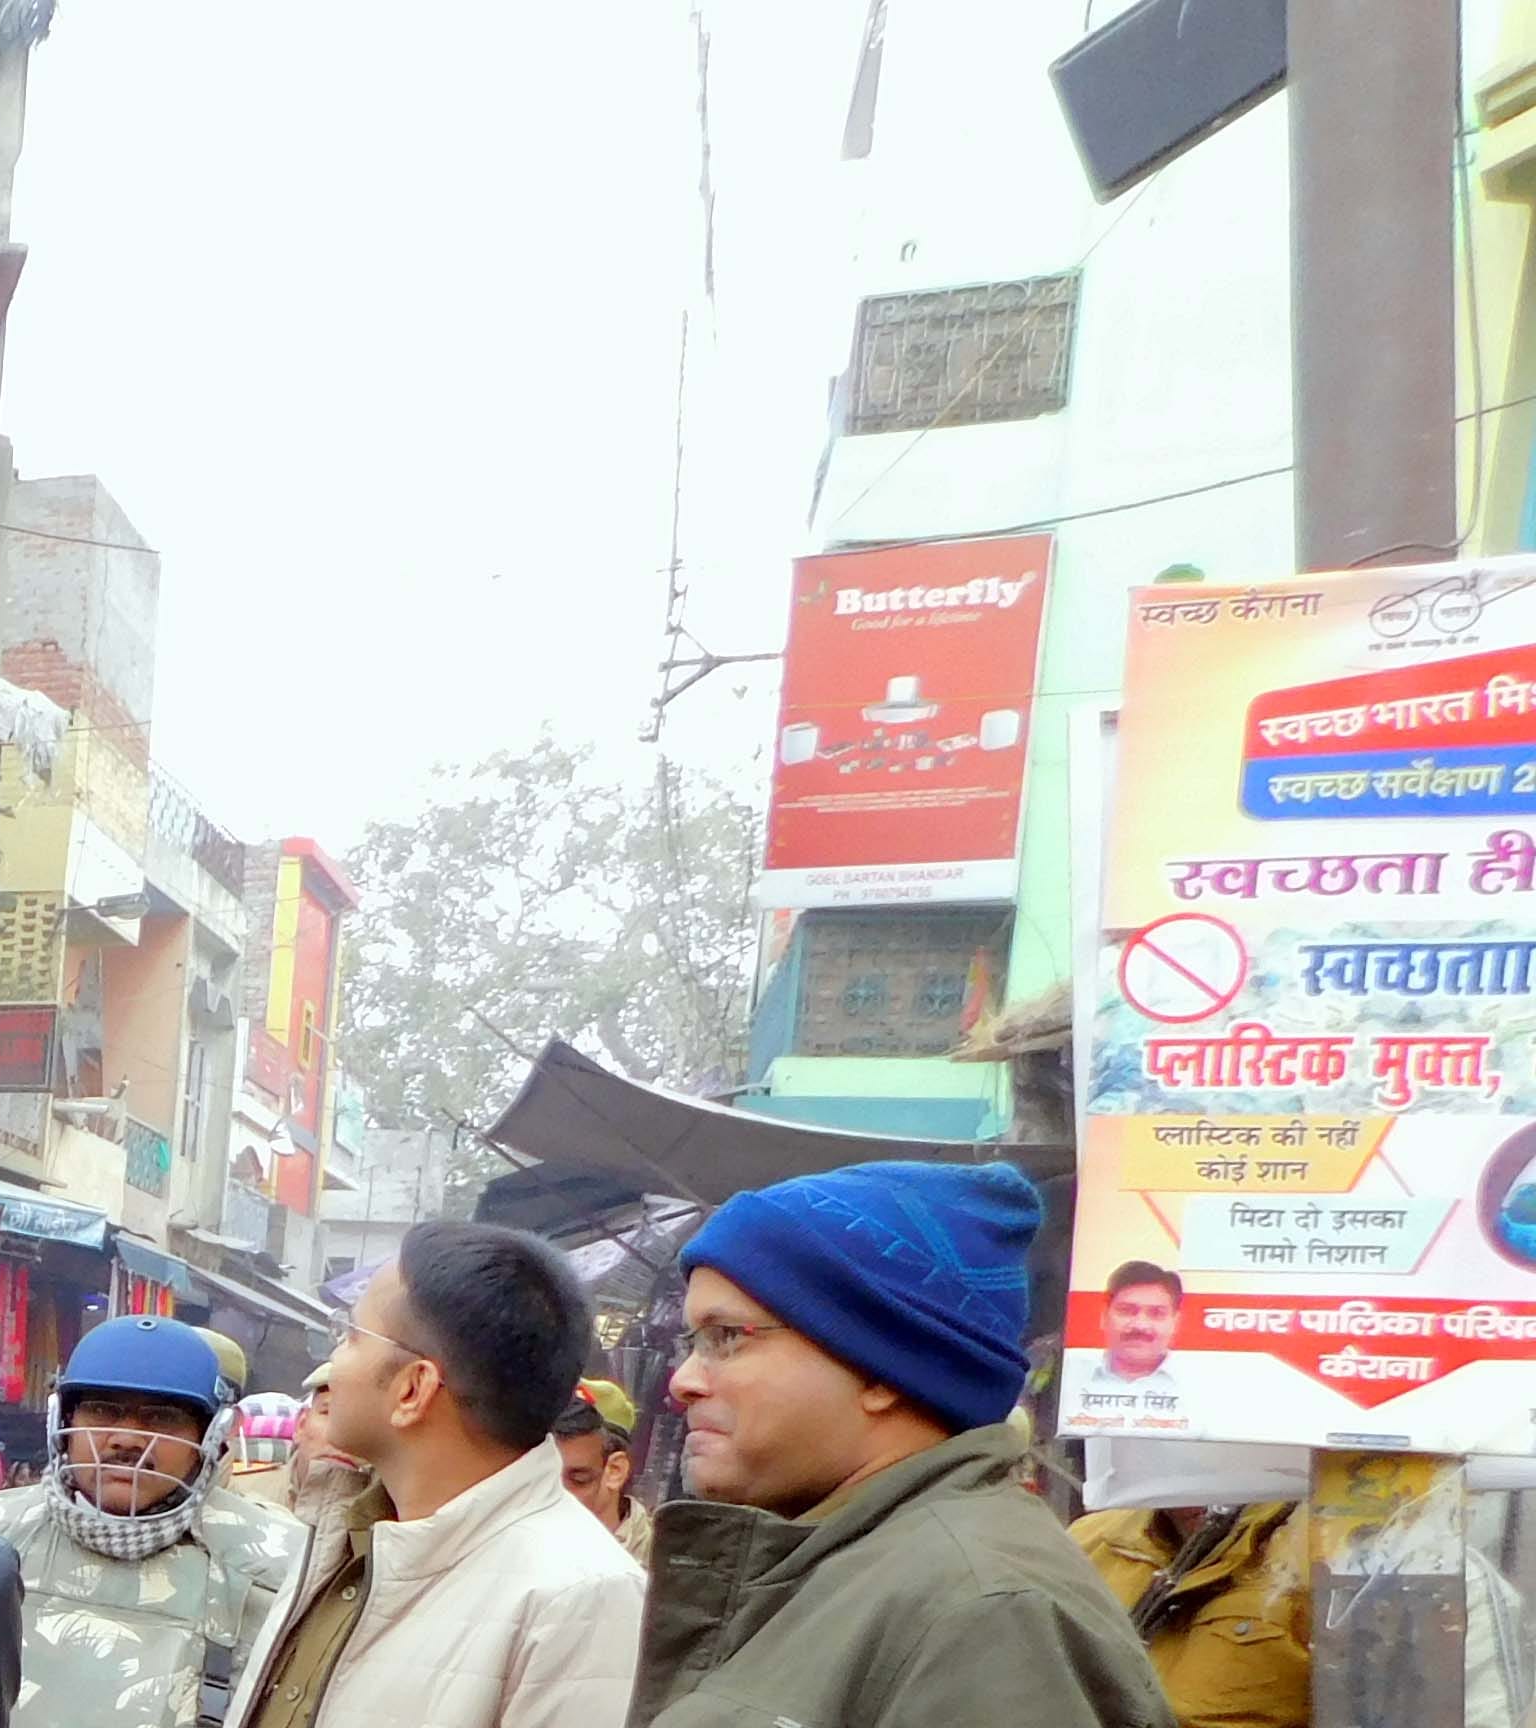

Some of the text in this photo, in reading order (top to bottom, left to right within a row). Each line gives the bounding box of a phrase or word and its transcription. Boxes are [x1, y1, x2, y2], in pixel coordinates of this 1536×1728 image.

[834, 576, 1025, 615] Butterfly
[1258, 704, 1369, 746] स्वच्छ
[1370, 690, 1476, 730] भारत
[1267, 770, 1370, 805] स्वच्छ
[1372, 757, 1506, 799] सर्वेक्षण
[1166, 851, 1450, 900] स्वच्छता
[1144, 1023, 1353, 1088] प्लास्टिक
[1153, 1119, 1360, 1149] प्लास्टिक की नहीं
[1196, 1155, 1308, 1185] कोई शान
[1230, 1203, 1408, 1232] मिटा दो इसका
[1241, 1241, 1387, 1265] नामो निशान
[1203, 1307, 1295, 1334] नगर
[1299, 1300, 1437, 1336] पालिका
